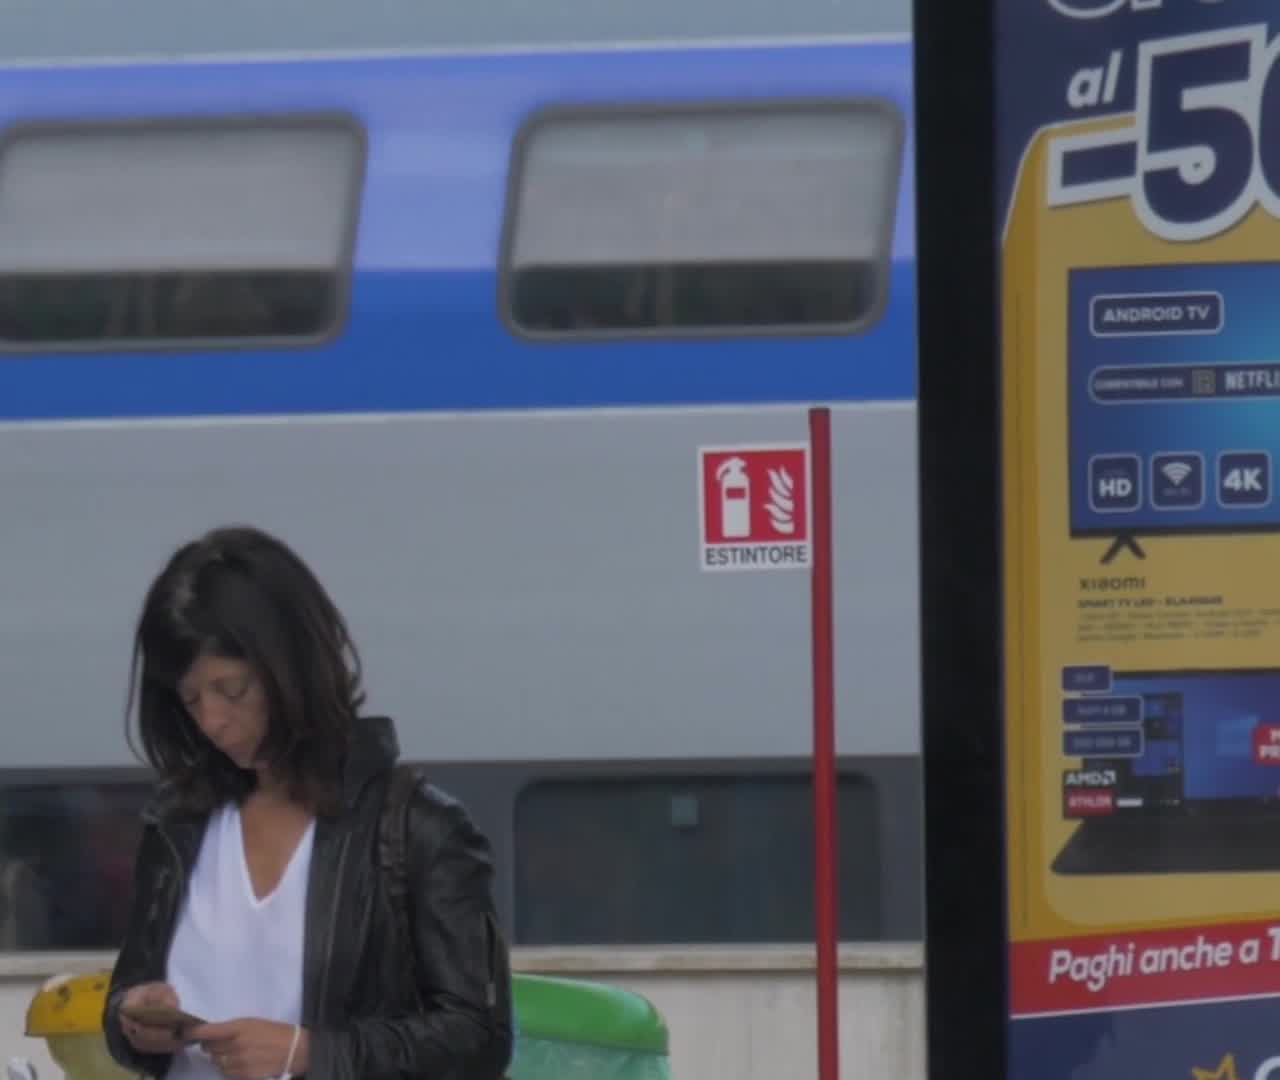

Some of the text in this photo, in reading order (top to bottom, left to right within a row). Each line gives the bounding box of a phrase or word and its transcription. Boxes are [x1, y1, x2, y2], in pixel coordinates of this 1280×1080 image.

[1066, 50, 1122, 108] al
[1103, 304, 1211, 323] ANDROID TV
[1099, 477, 1132, 497] HD
[1223, 466, 1263, 492] 4K
[705, 545, 809, 567] ESTINTORE
[1048, 942, 1136, 991] Paghi
[1140, 934, 1233, 974] anche
[1240, 938, 1260, 964] a
